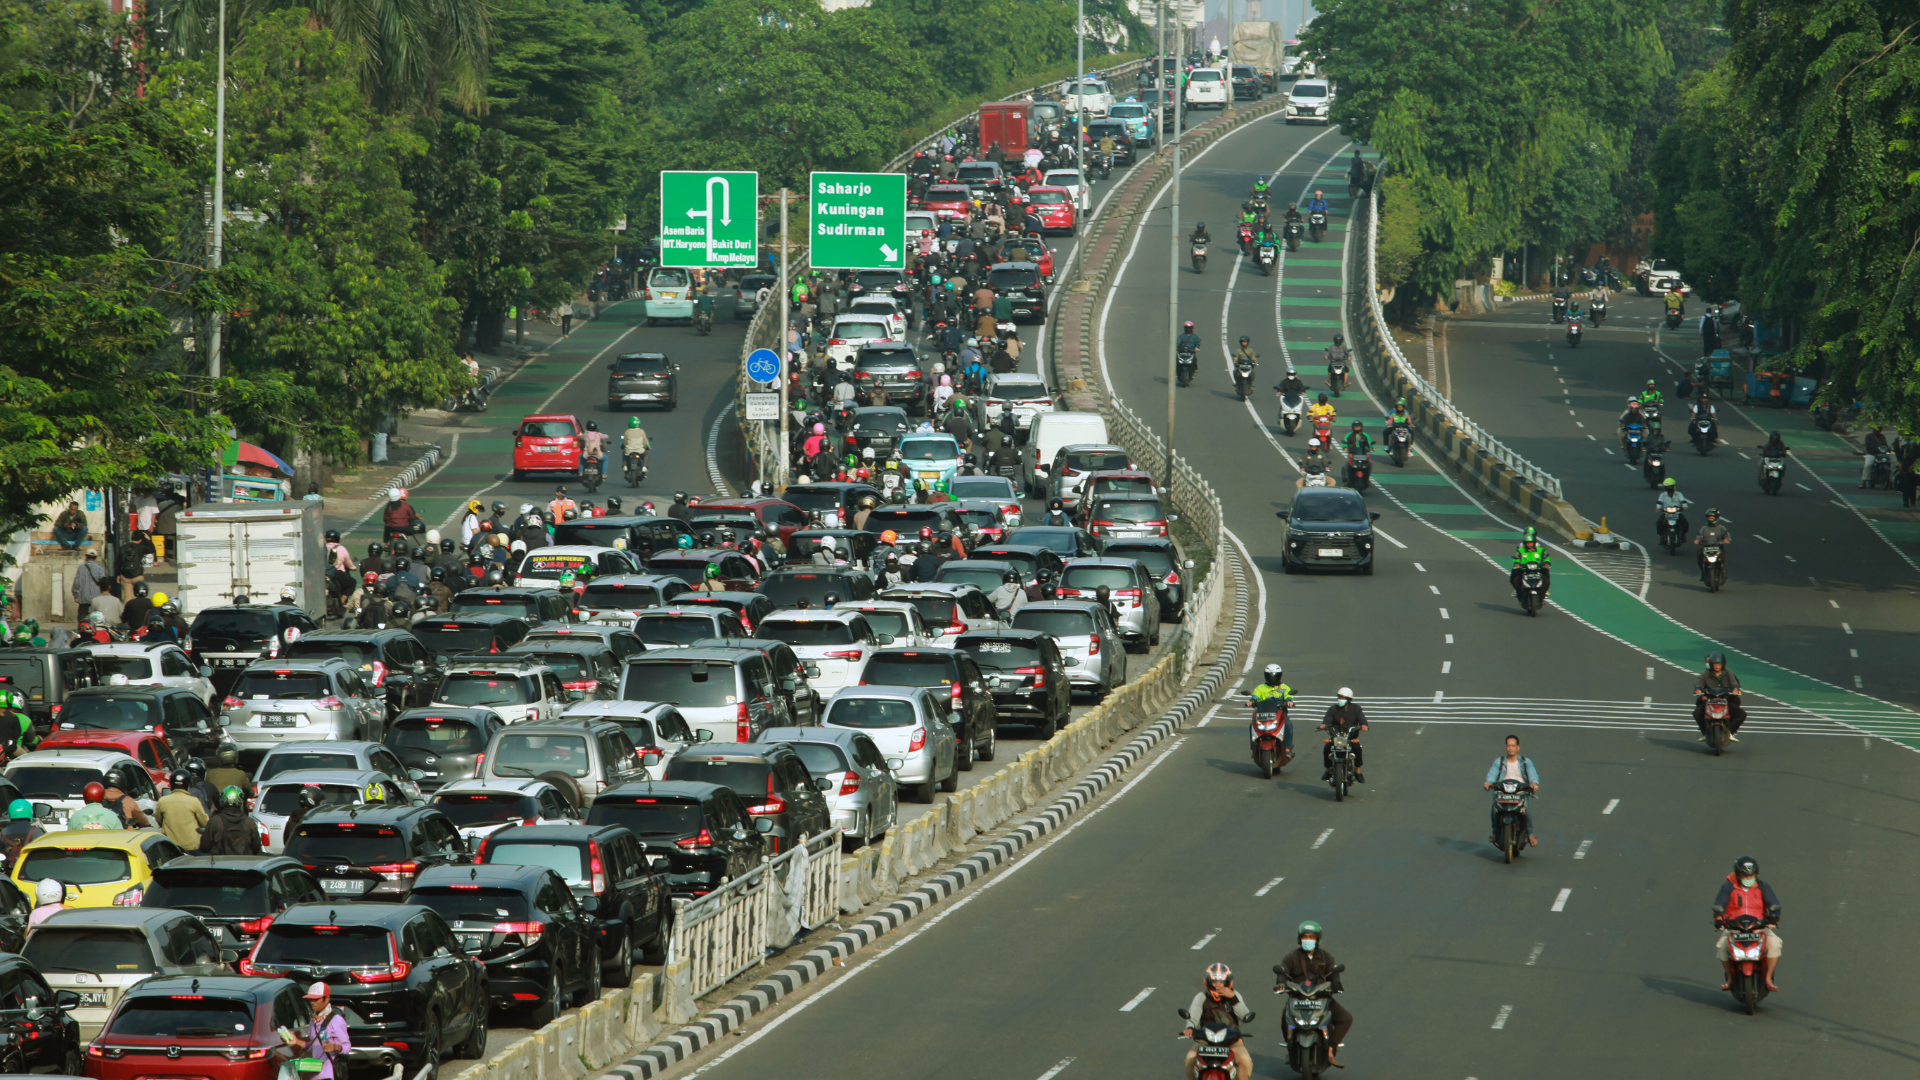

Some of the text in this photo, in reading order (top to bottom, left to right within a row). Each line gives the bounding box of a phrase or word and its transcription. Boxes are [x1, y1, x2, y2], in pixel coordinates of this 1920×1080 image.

[817, 182, 872, 197] Saharjo
[817, 203, 885, 219] Kuningan
[663, 226, 705, 235] Asem Baris
[817, 223, 886, 236] Sudirman
[663, 239, 707, 251] MT.Haryono
[712, 239, 752, 249] Bukit Duri
[712, 253, 756, 264] Kmp Melayu
[330, 880, 347, 889] 2489
[351, 881, 364, 890] TIF
[92, 993, 107, 1003] NYV
